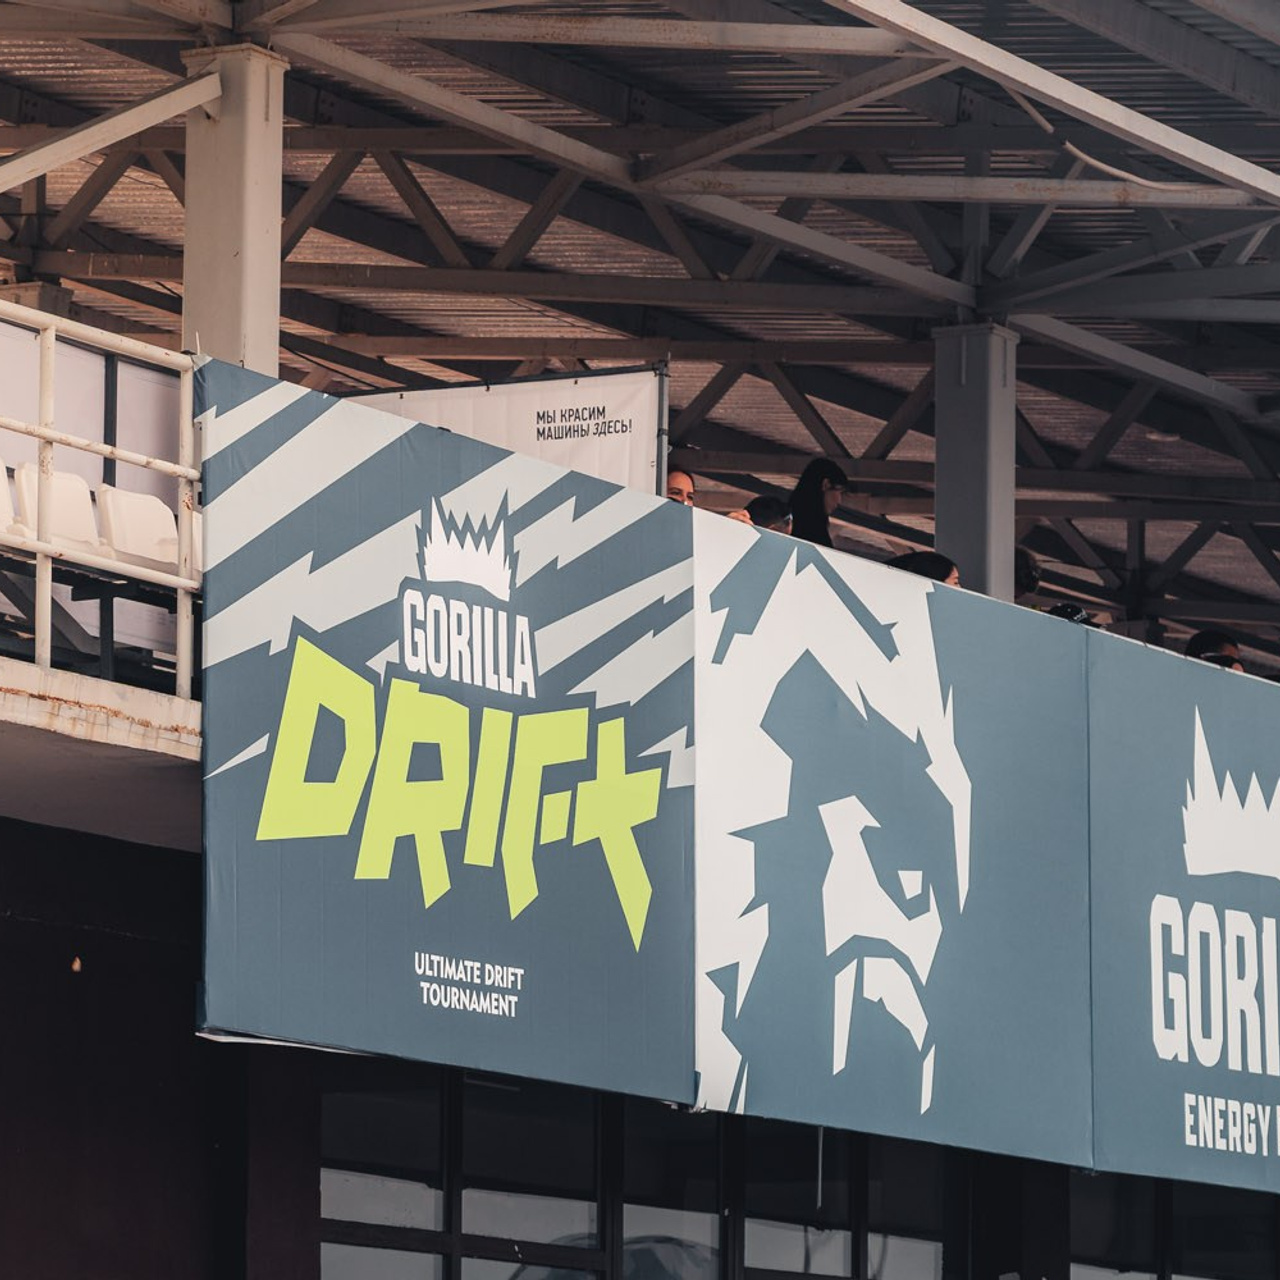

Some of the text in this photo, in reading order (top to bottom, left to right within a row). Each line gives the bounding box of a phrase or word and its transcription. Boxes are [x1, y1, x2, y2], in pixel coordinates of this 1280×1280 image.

[536, 406, 606, 424] МЫ КРАСИМ
[536, 419, 632, 441] МАШИНЫ ЗДЕСЬ!
[403, 588, 537, 699] GORILLA
[414, 951, 525, 990] ULTIMATE DRIFT
[420, 981, 518, 1018] TOURNAMENT
[1184, 1092, 1271, 1157] ENERGY
